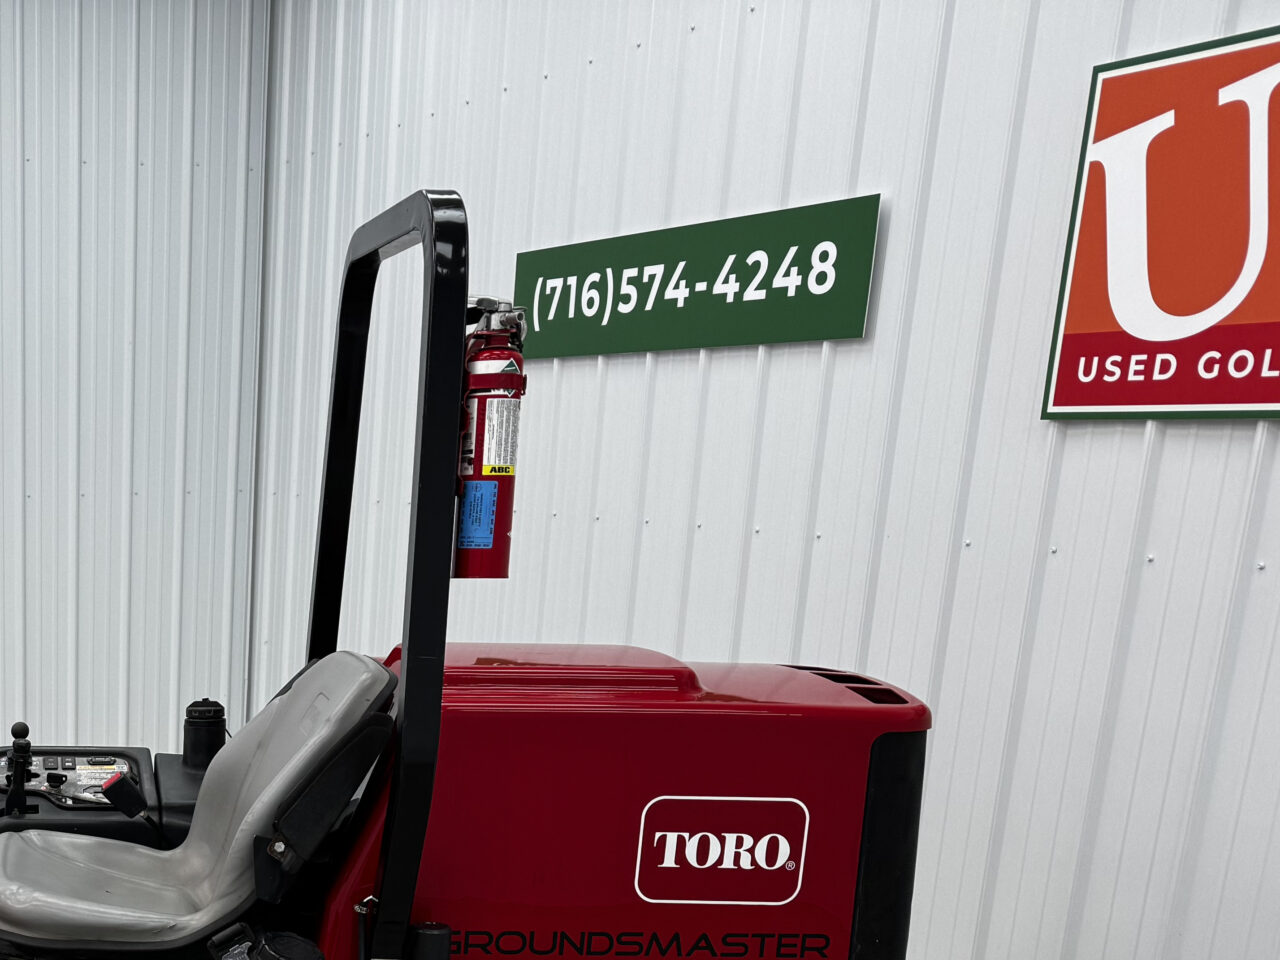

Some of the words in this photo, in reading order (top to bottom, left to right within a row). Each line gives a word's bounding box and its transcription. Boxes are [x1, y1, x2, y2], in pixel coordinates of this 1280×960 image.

[533, 240, 838, 332] (716)574-4248
[1077, 353, 1178, 383] USED
[1197, 348, 1280, 380] GOL
[489, 466, 511, 474] ABC
